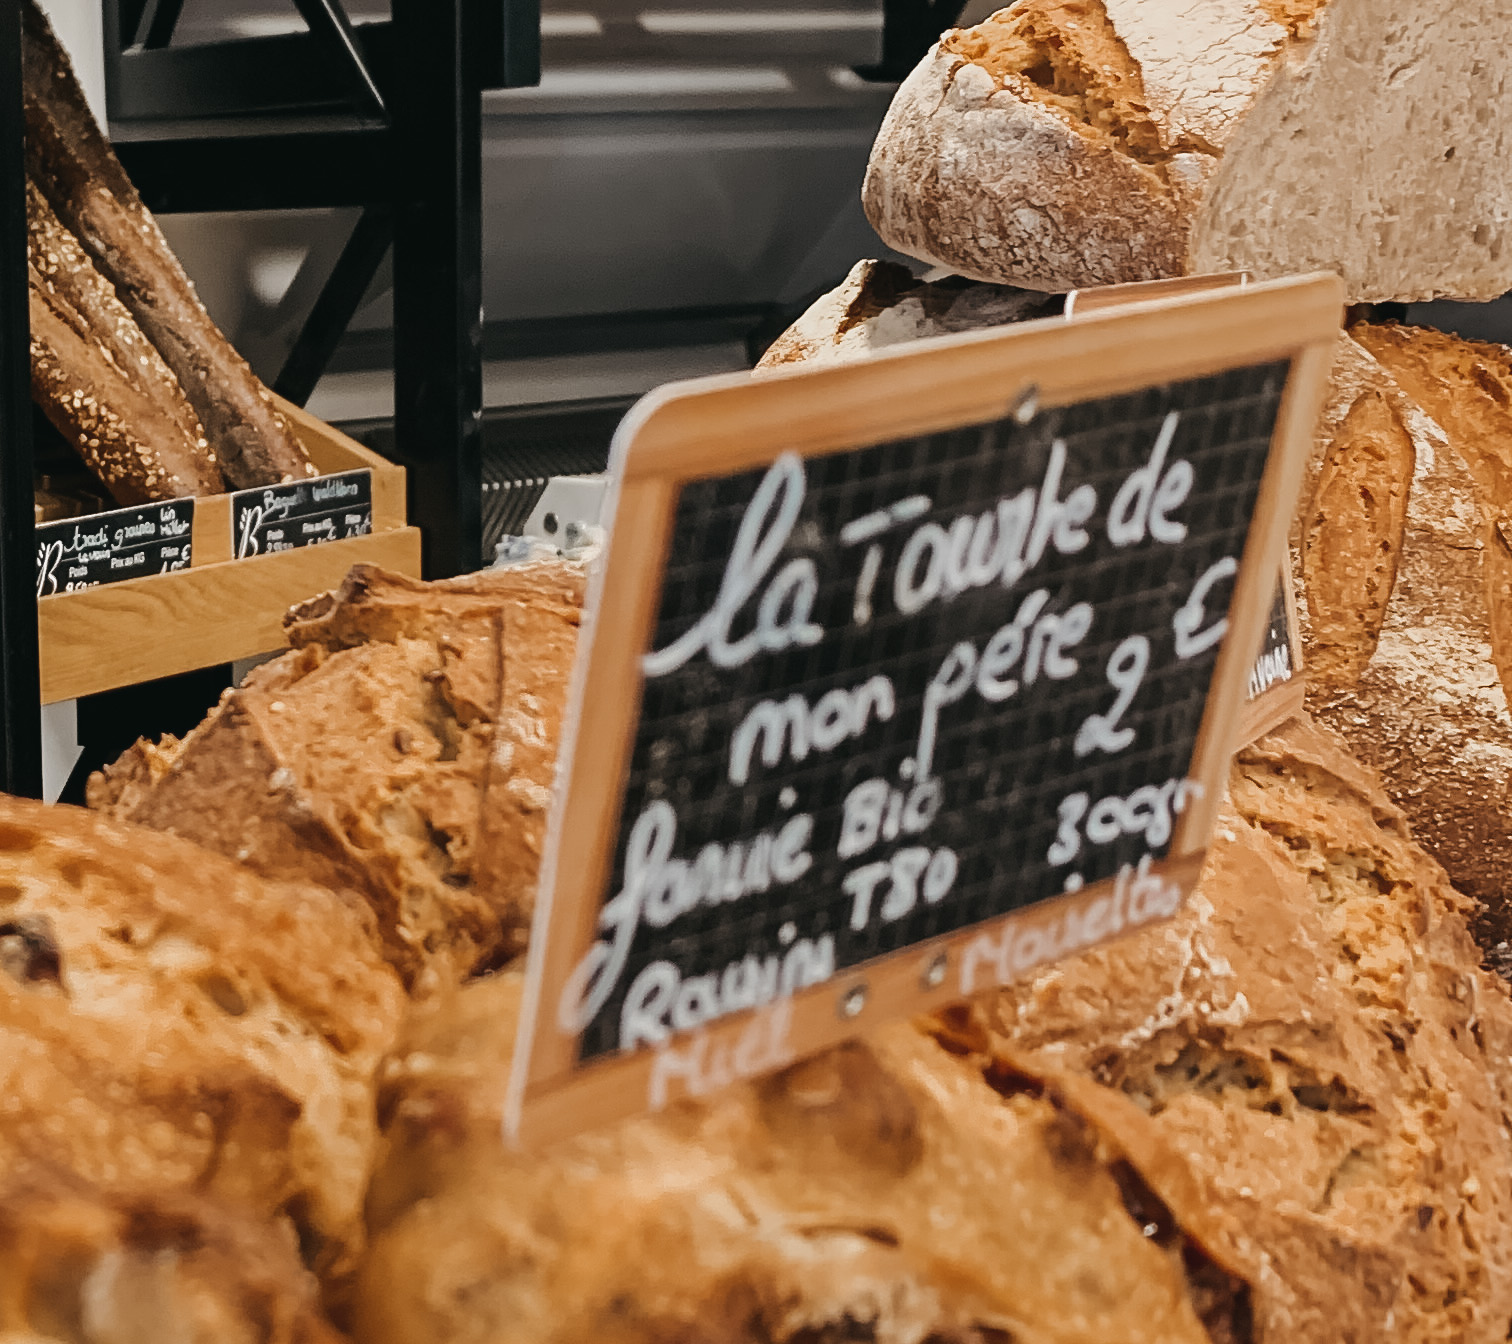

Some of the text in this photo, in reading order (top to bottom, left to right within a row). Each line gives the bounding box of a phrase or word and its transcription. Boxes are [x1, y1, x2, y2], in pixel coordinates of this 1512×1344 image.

[840, 440, 1096, 623] Tourte
[1108, 412, 1193, 546] de
[729, 674, 894, 785] mon
[838, 757, 942, 857] Bio
